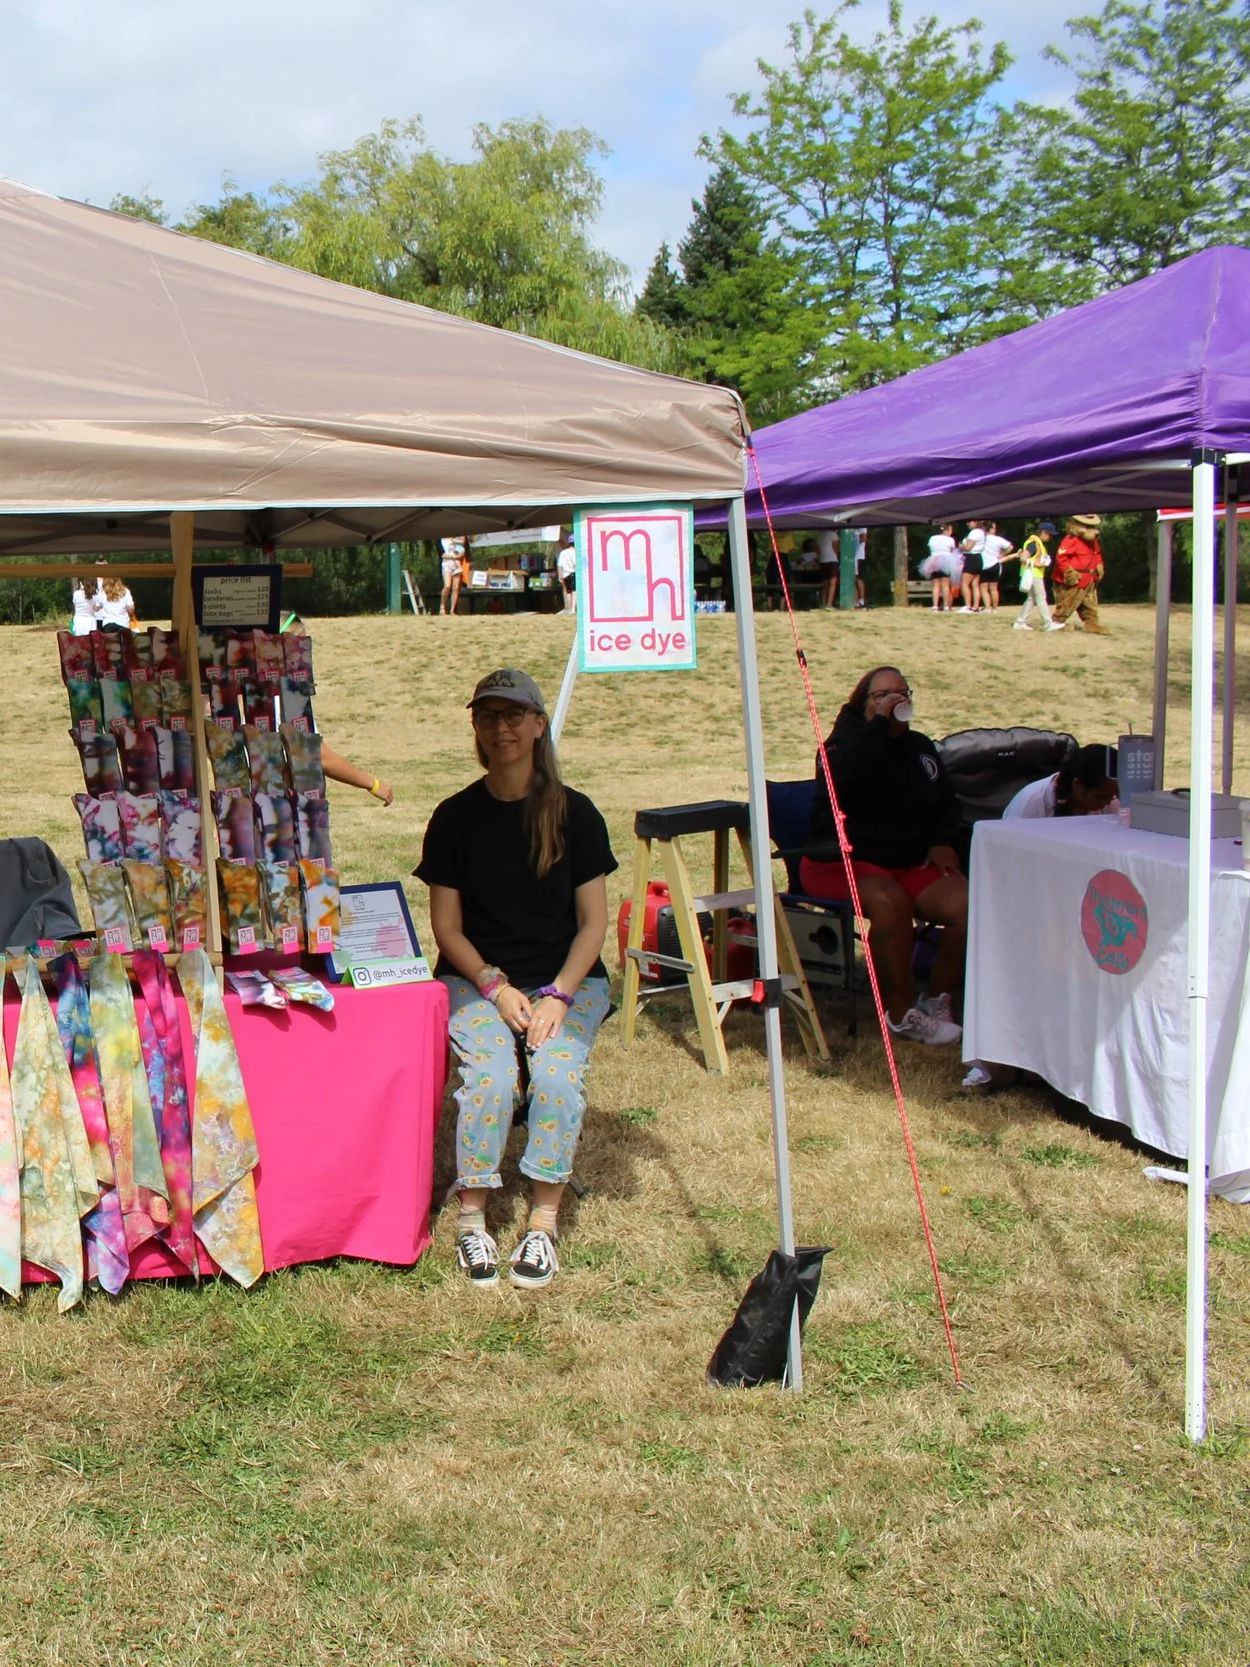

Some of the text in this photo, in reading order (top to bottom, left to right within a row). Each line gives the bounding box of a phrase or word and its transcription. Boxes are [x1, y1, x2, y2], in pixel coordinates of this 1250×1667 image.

[589, 628, 686, 656] ice dye
[372, 964, 428, 980] @mh_icedye
